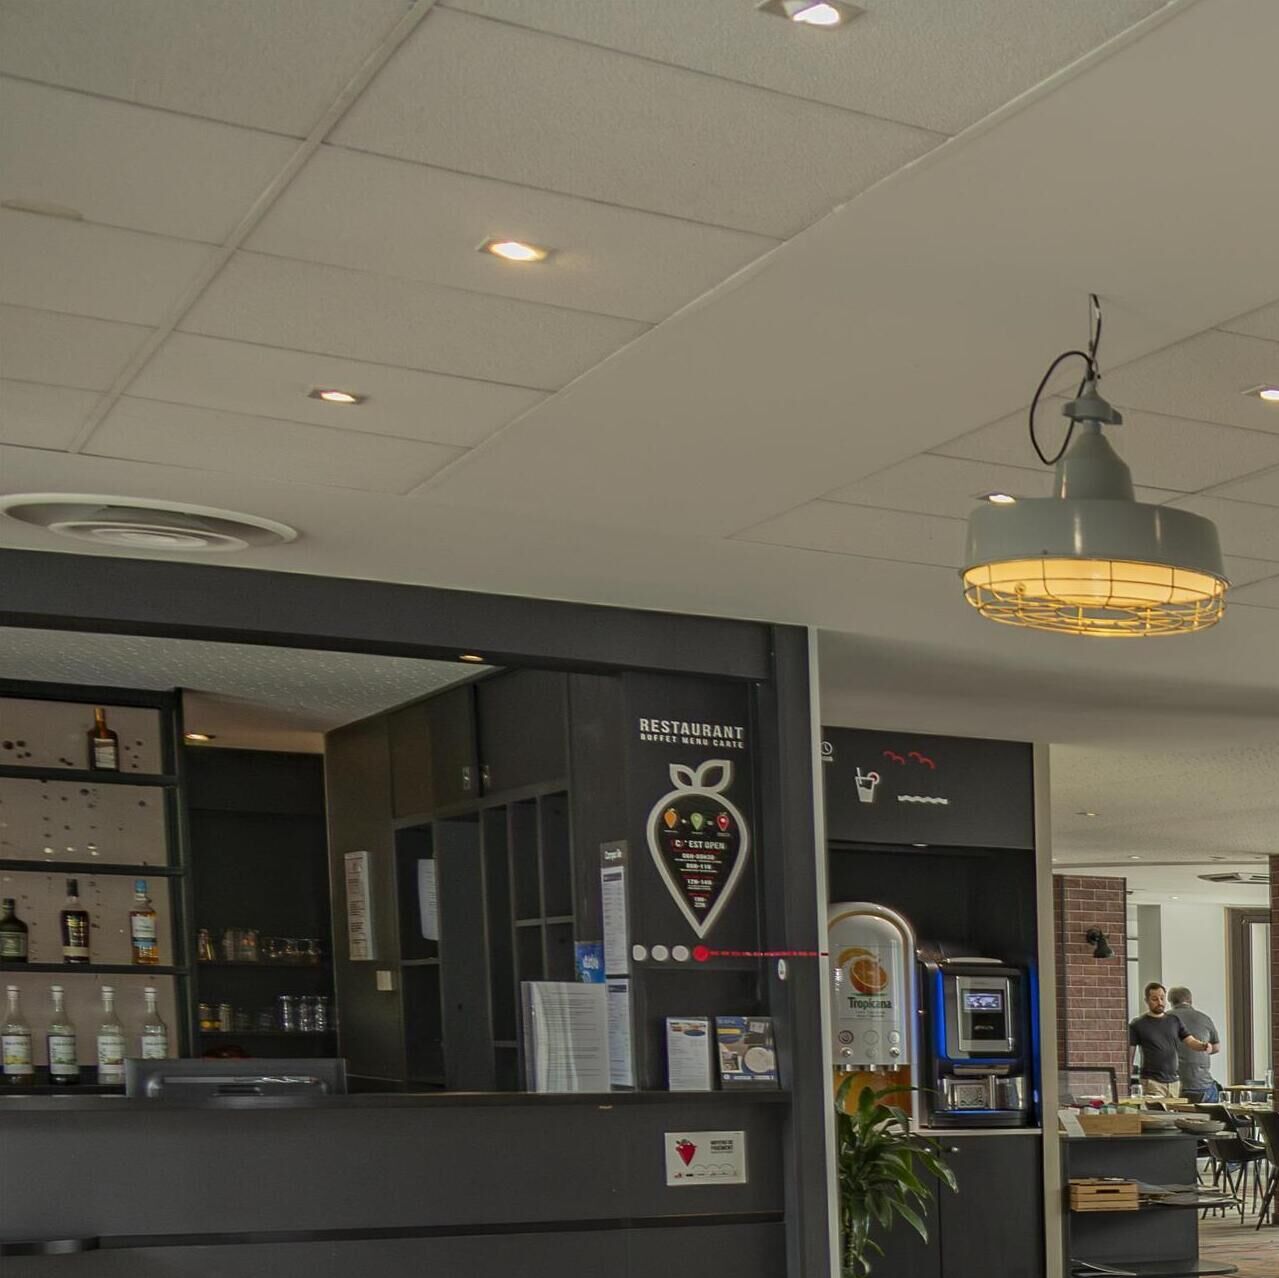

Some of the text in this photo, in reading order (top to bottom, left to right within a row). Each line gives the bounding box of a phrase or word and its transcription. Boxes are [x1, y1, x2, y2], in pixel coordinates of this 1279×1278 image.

[639, 718, 744, 739] RESTAURANT
[681, 736, 709, 746] MENU
[712, 739, 744, 749] CARTE
[705, 841, 726, 850] OPEN
[848, 996, 893, 1010] Tropicana
